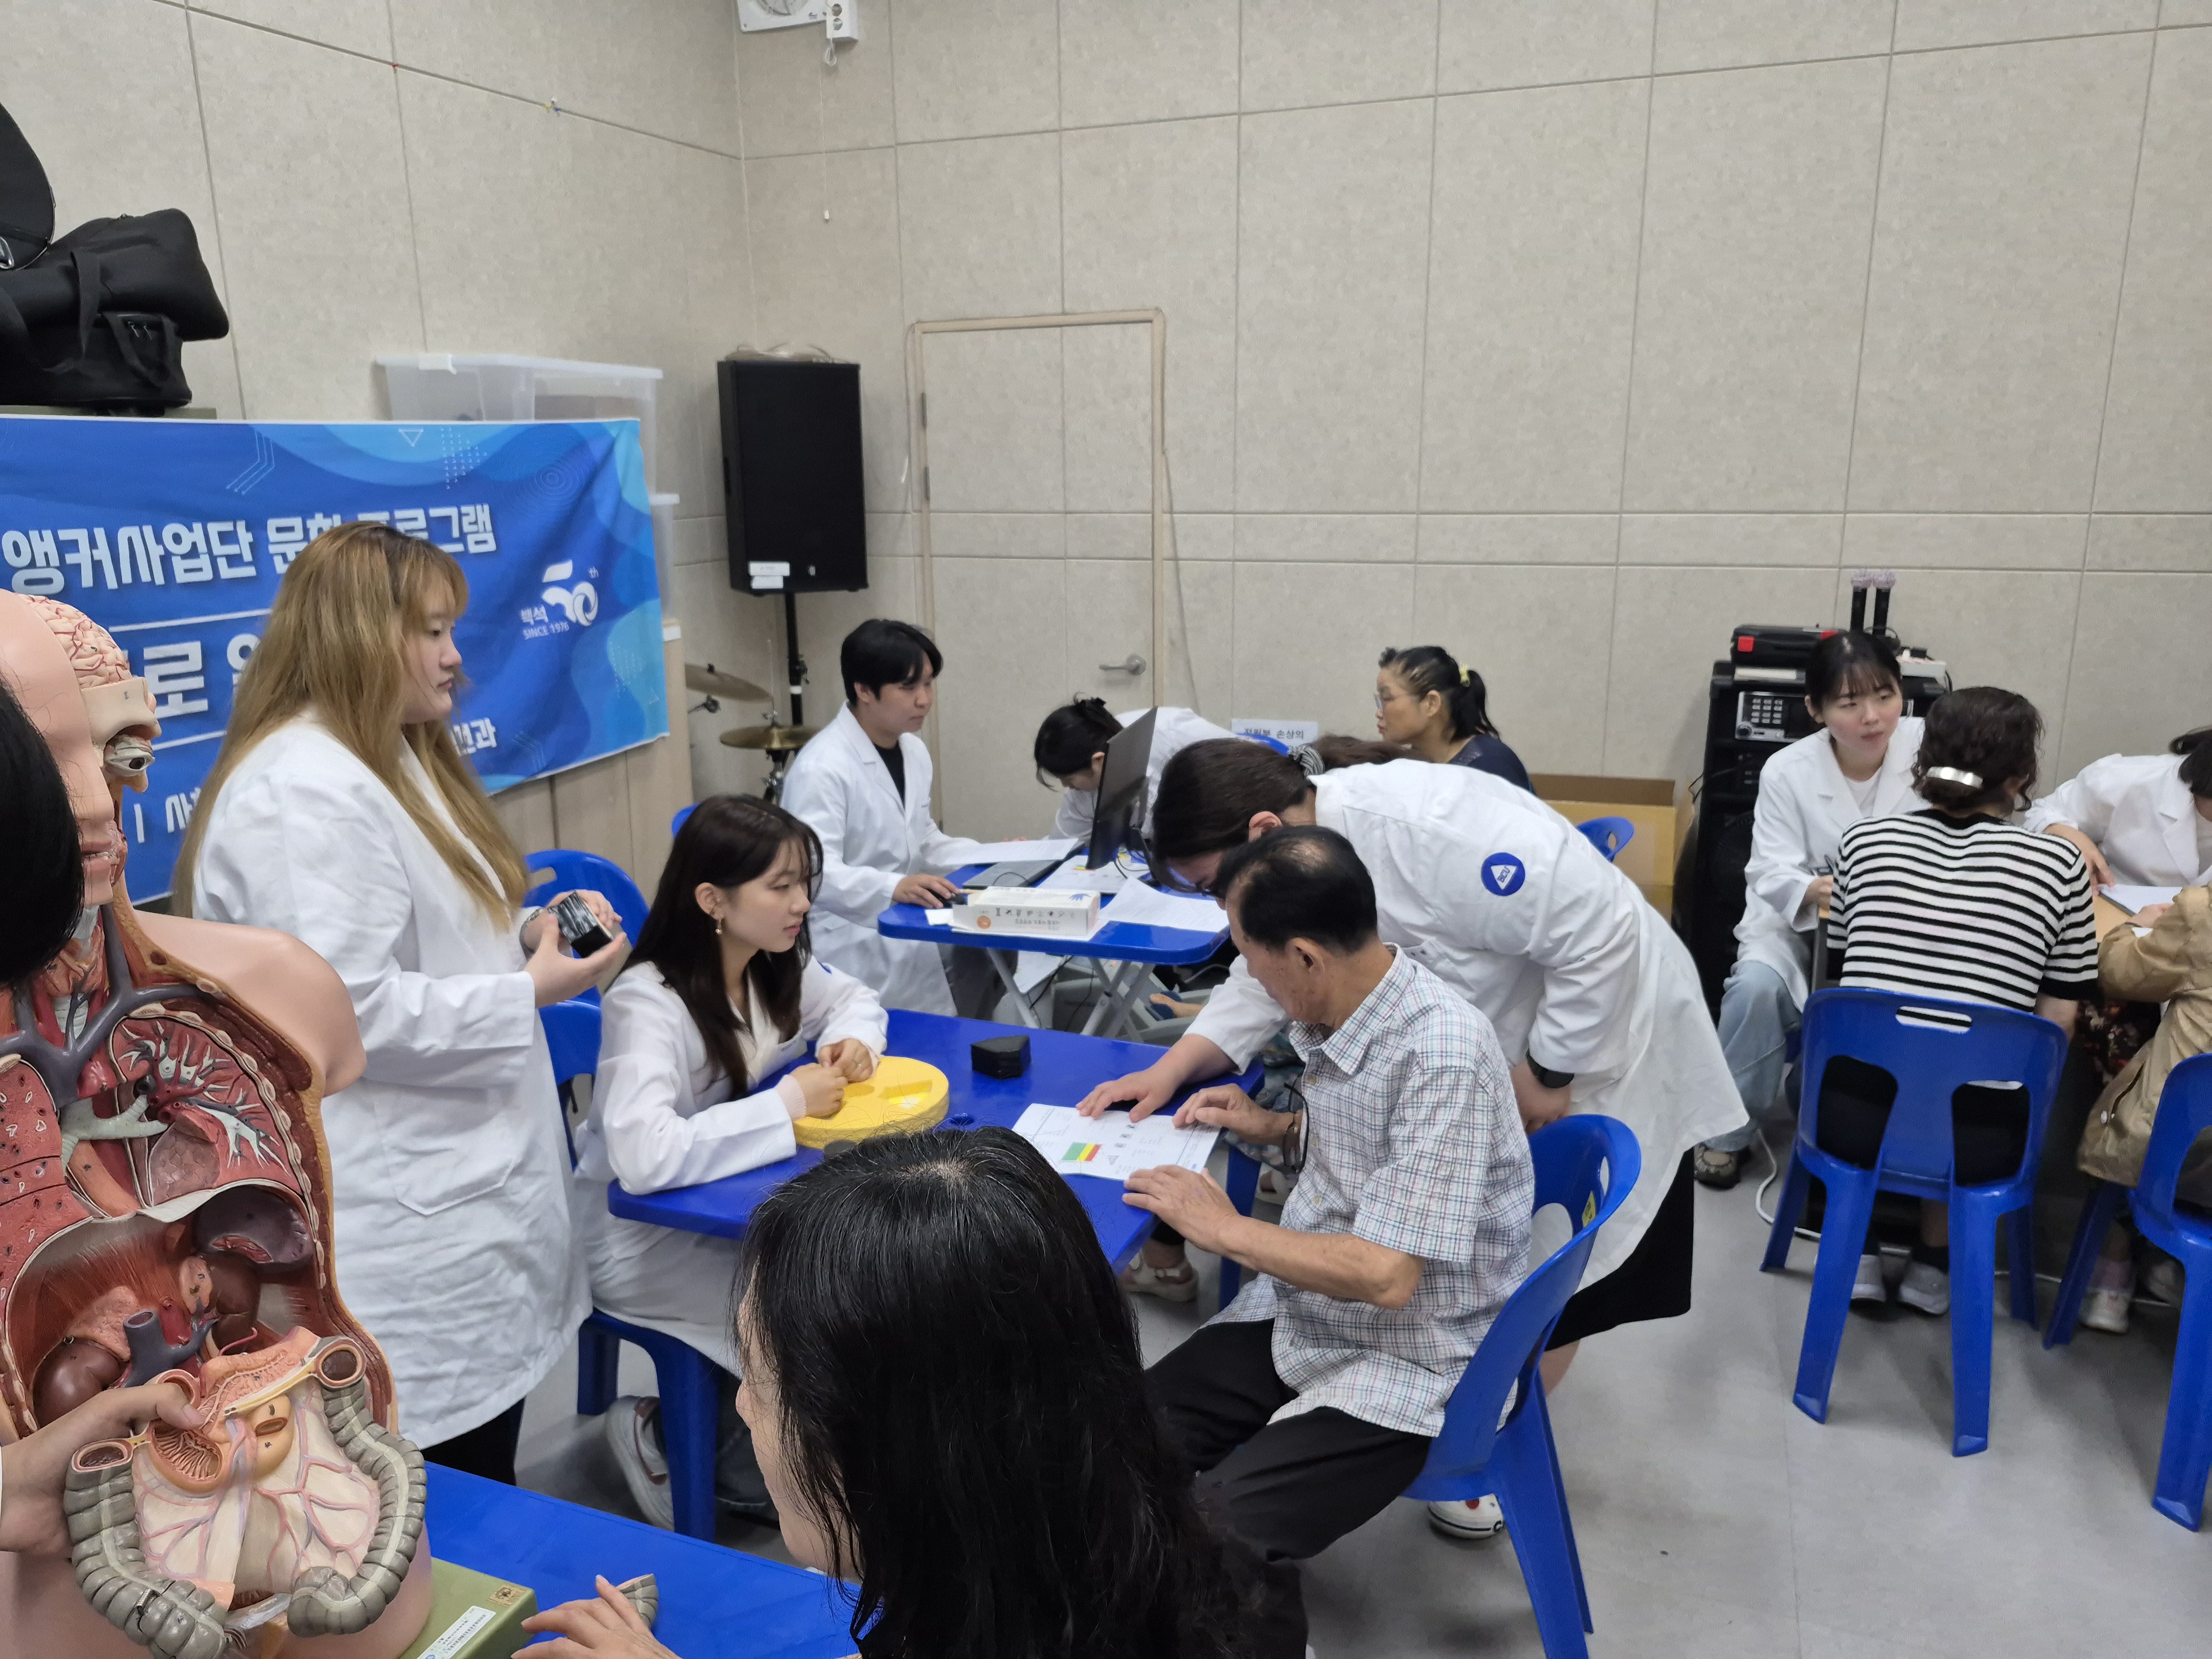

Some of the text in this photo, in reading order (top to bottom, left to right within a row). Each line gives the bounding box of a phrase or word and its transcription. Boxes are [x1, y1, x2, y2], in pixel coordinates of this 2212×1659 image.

[2, 520, 257, 595] 앵커사업단
[520, 603, 549, 625] 백석
[523, 625, 549, 640] SINCE
[1276, 729, 1304, 740] 손상의
[165, 787, 201, 833] 사
[1496, 865, 1510, 883] BCU
